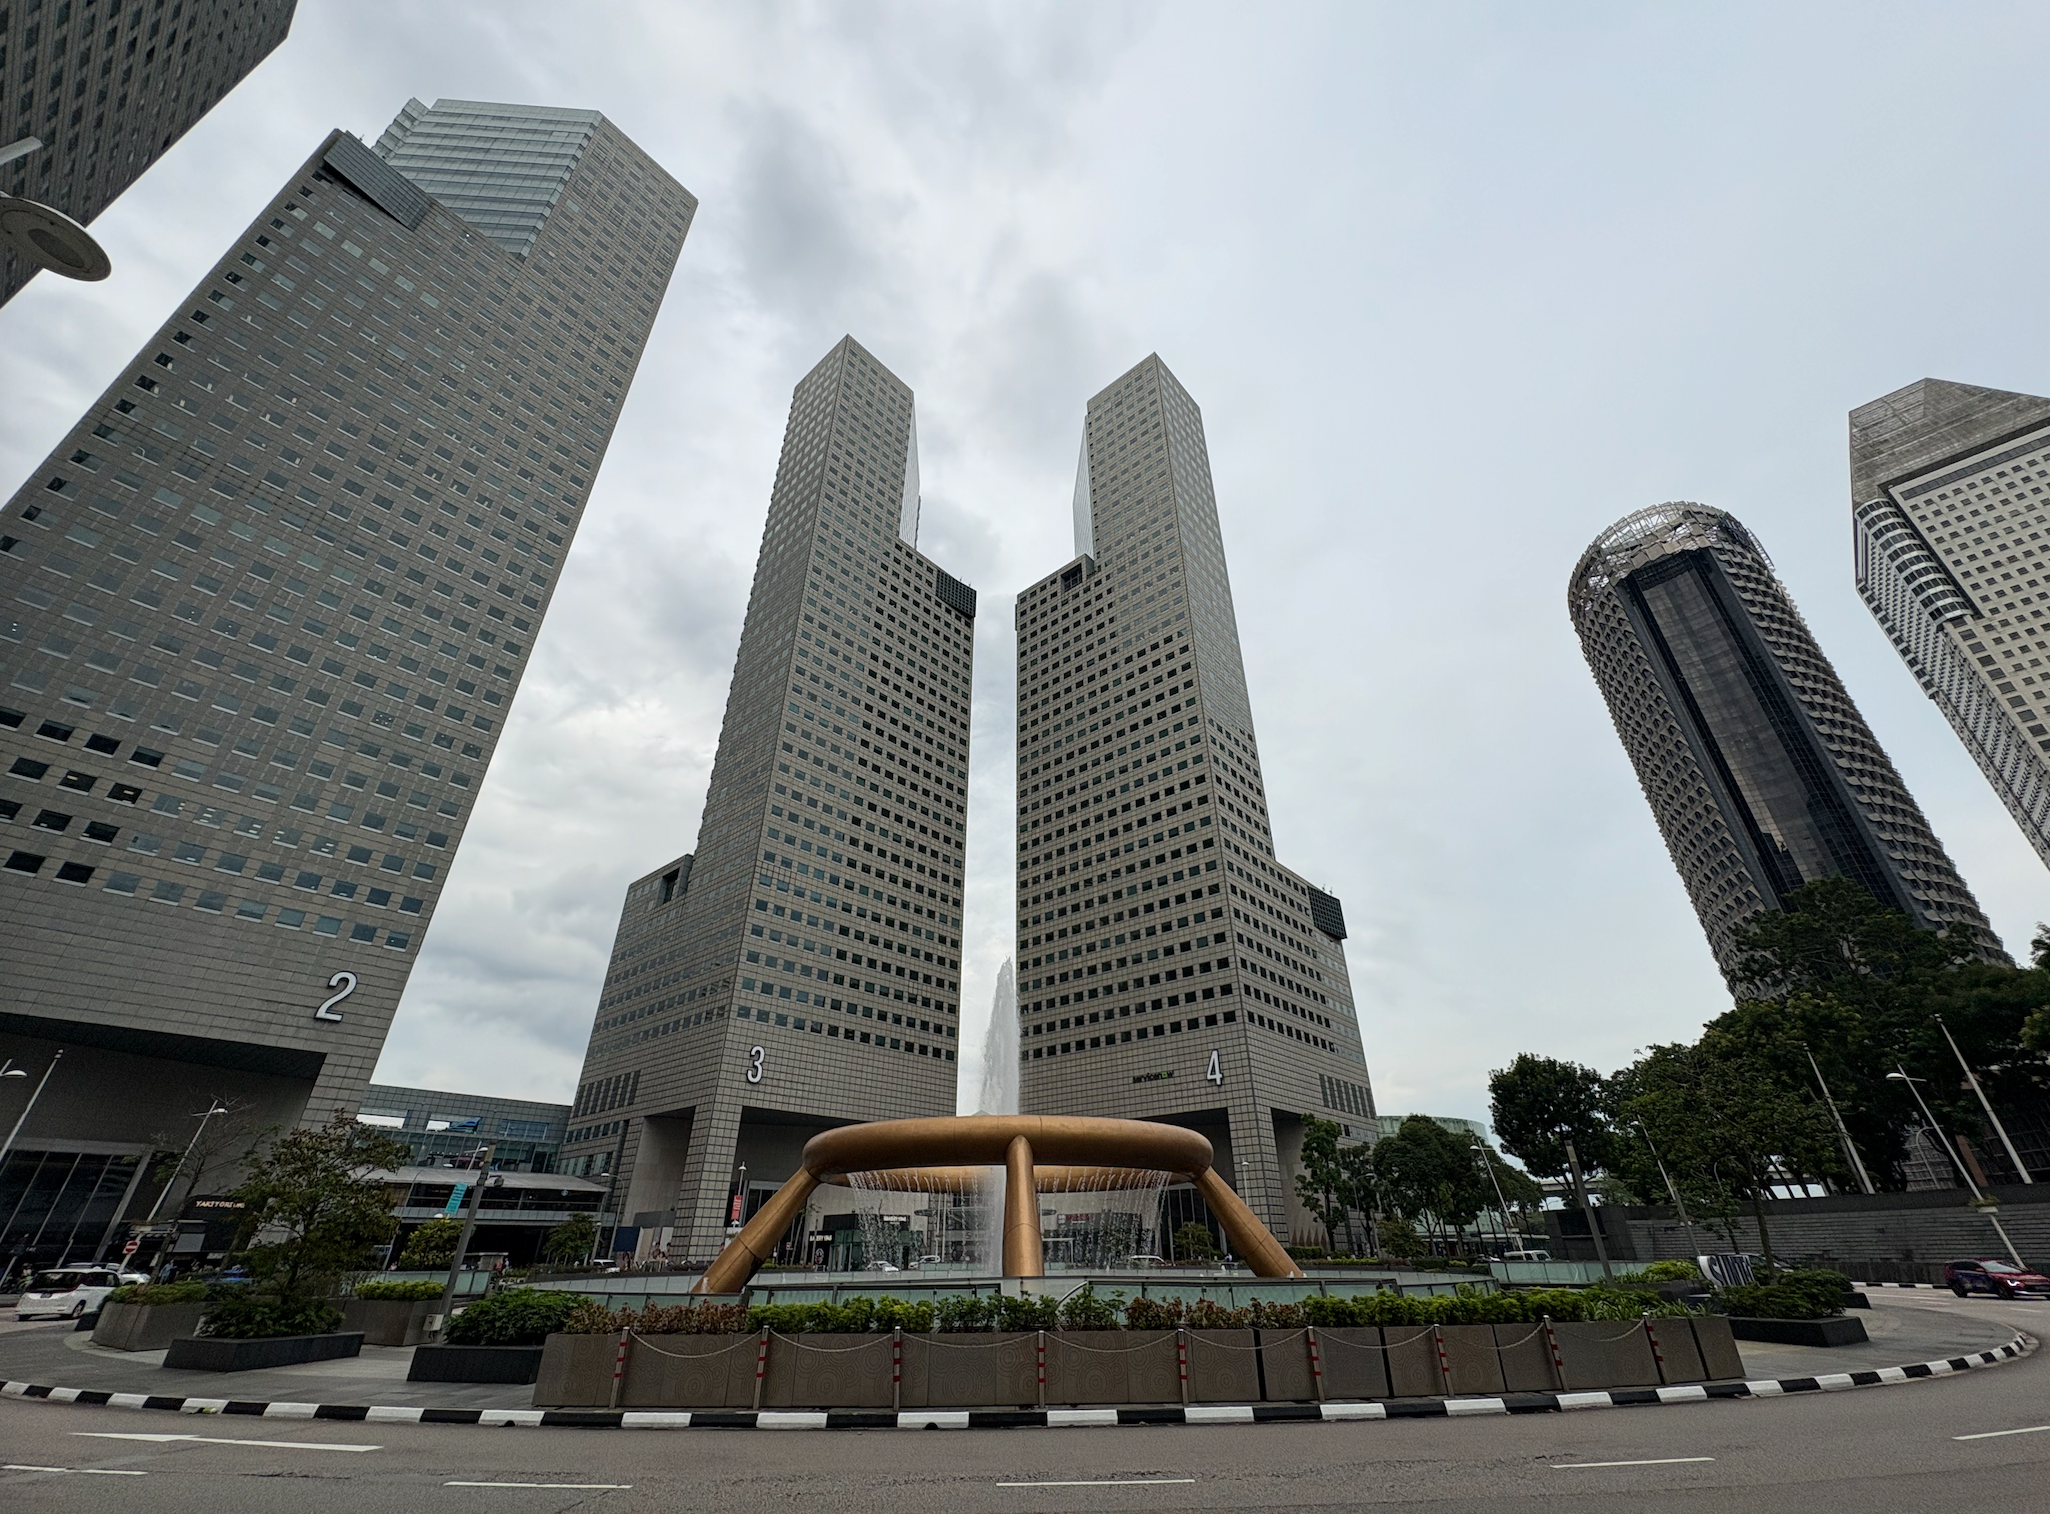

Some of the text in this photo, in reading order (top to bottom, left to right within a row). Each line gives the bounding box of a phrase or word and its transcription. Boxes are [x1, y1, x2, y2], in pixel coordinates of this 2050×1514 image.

[314, 970, 357, 1022] 2
[747, 1045, 765, 1083] 3
[1206, 1049, 1223, 1086] 4
[195, 1200, 234, 1208] YAKITORI
